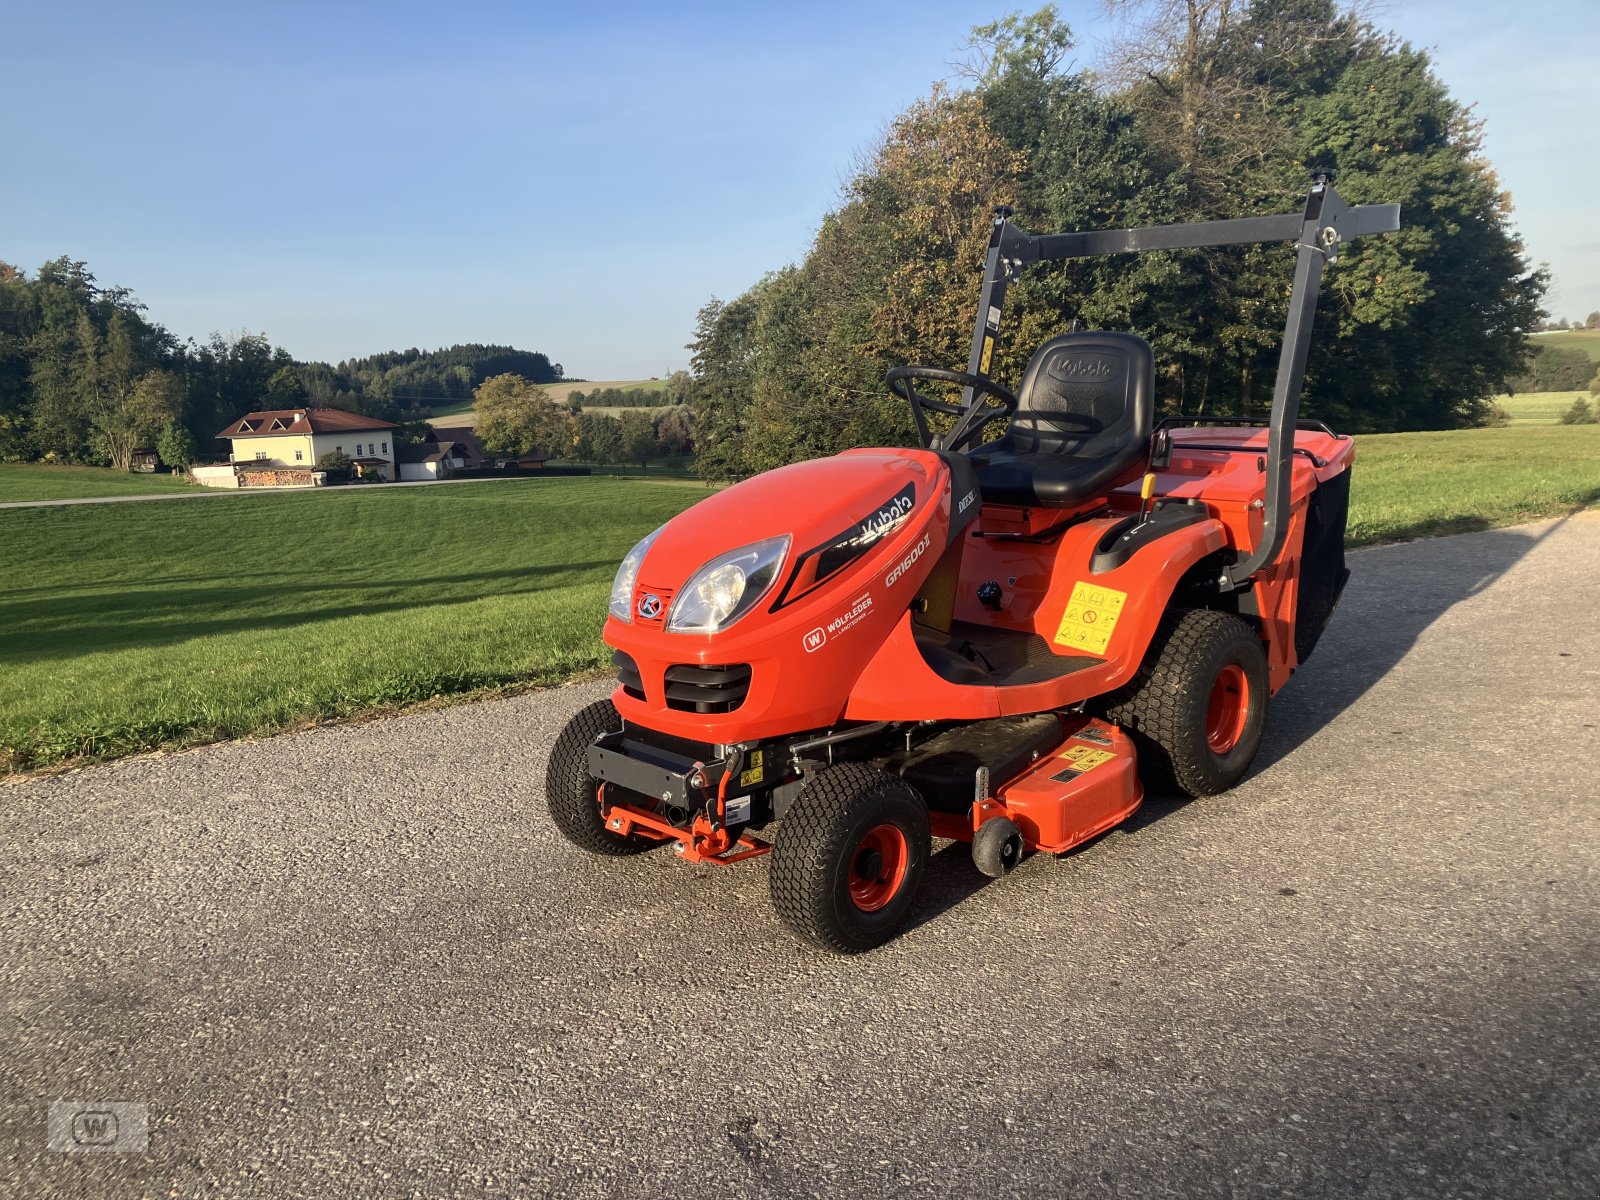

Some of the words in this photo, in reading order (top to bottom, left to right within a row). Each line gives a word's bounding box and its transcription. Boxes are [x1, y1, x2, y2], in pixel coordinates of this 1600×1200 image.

[1057, 359, 1112, 376] Kubota
[958, 488, 977, 514] DIES
[861, 496, 913, 536] Kubota
[826, 597, 873, 633] WÖLFLEDER
[807, 631, 821, 648] W
